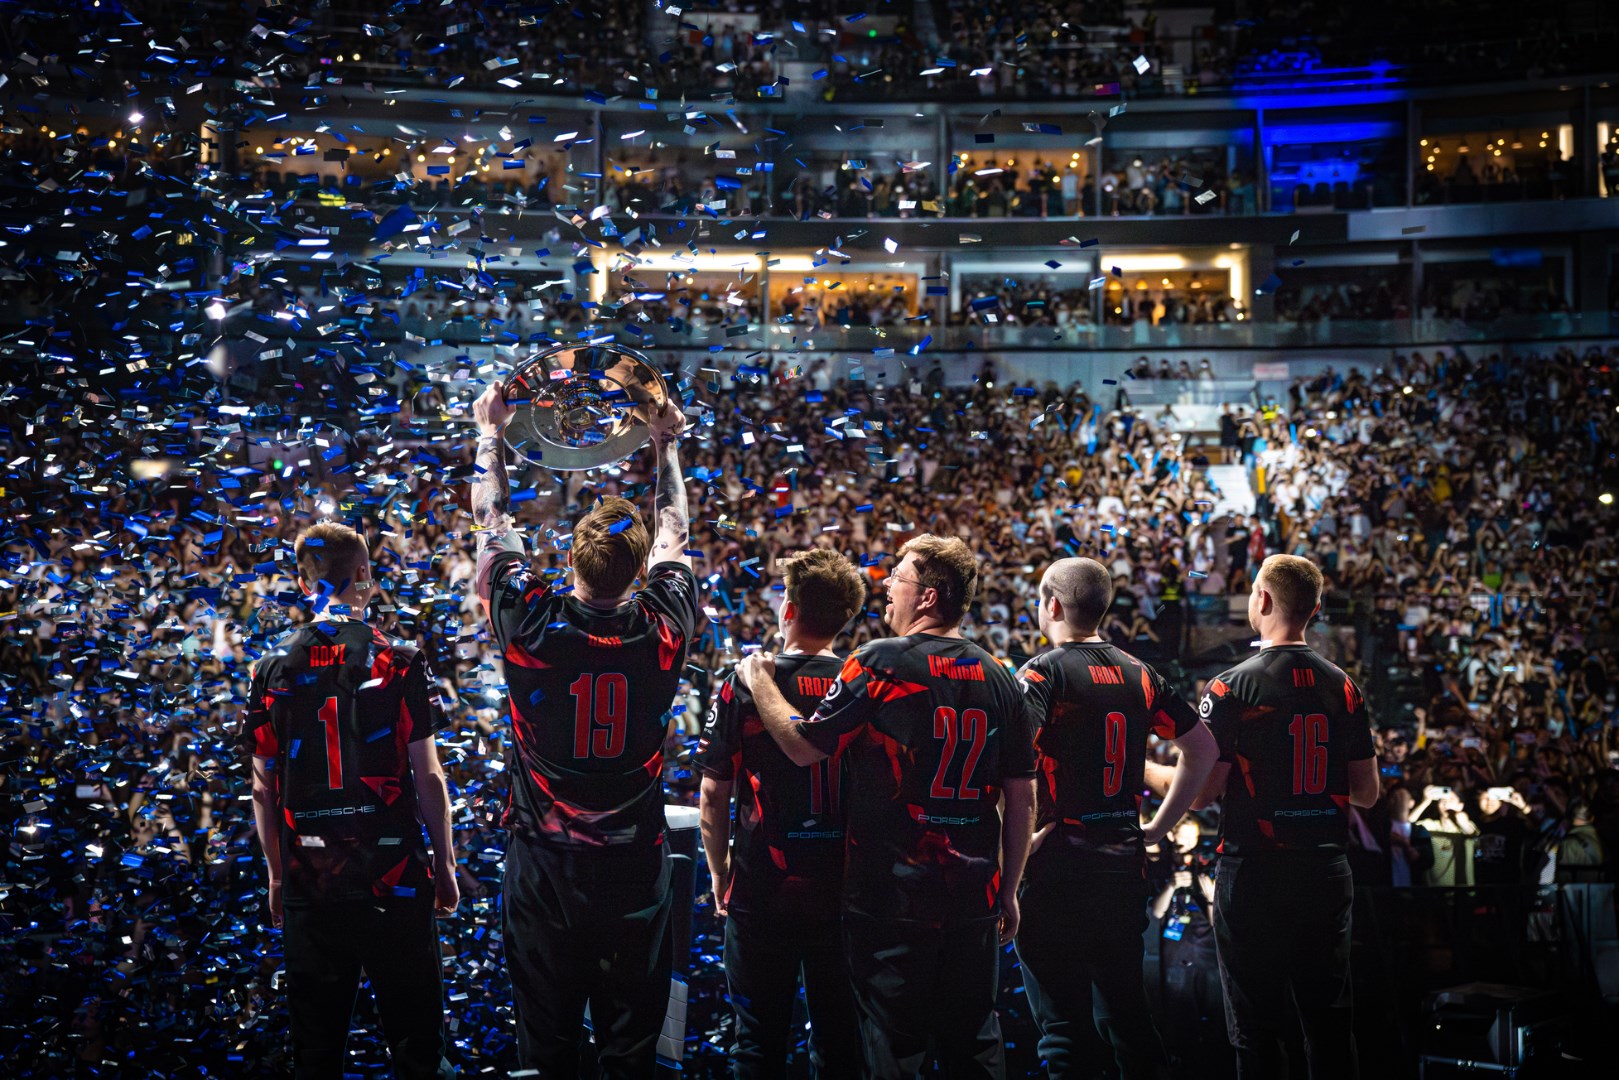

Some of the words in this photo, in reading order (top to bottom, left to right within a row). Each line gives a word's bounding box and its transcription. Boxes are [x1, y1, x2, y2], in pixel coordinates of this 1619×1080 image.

[310, 643, 346, 667] ROPZ
[1087, 665, 1125, 685] BROKY
[797, 676, 835, 697] FROZ
[569, 672, 628, 759] 19
[317, 695, 344, 790] 1
[930, 706, 988, 800] 22
[1103, 711, 1127, 798] 9
[1288, 713, 1329, 796] 16
[293, 804, 377, 820] PORSCHE
[1274, 808, 1338, 818] PORSCHE
